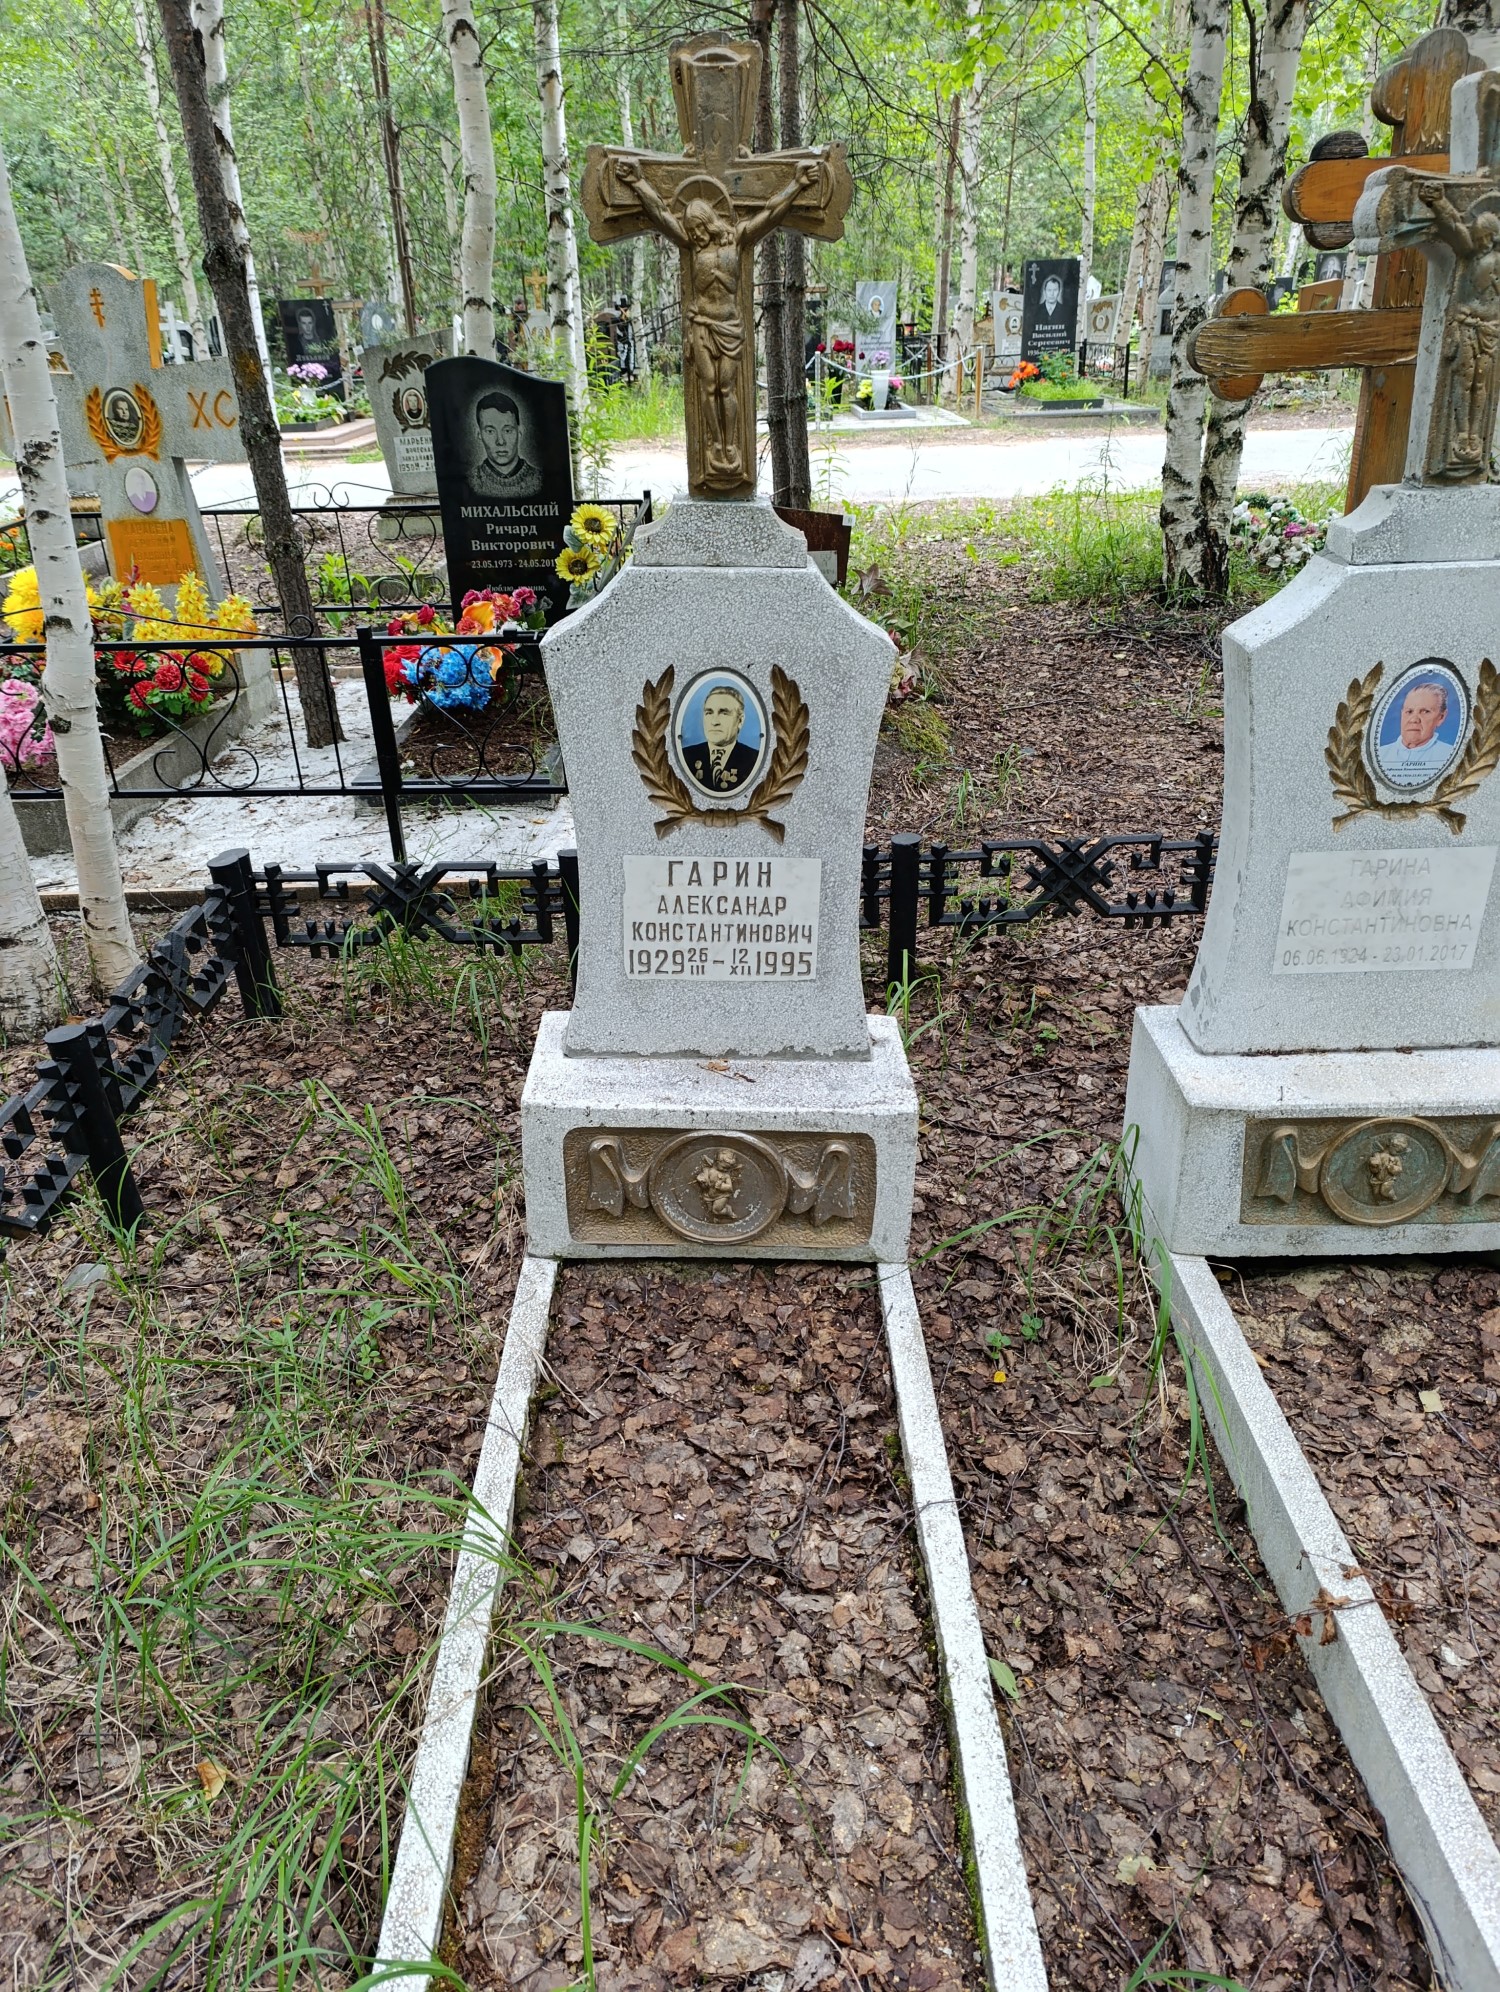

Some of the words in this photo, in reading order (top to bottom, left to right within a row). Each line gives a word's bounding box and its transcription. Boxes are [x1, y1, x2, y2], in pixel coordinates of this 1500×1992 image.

[460, 501, 560, 518] МИХАЛЬСКИЙ
[486, 523, 538, 536] Ричард
[471, 539, 555, 553] Викторович
[471, 560, 513, 569] 23.05.1973
[518, 559, 555, 568] 24.05.201
[667, 860, 772, 888] ГАРИН
[1350, 857, 1431, 878] ГАРИНА
[657, 895, 787, 917] АЛЕКСАНДР
[1340, 887, 1433, 909] АФИМИЯ
[632, 921, 813, 944] КОНСТАНТИНОВИЧ
[1286, 914, 1472, 937] КОНСТАНТИНОВНА
[629, 949, 685, 975] 1929
[755, 951, 813, 976] 1995
